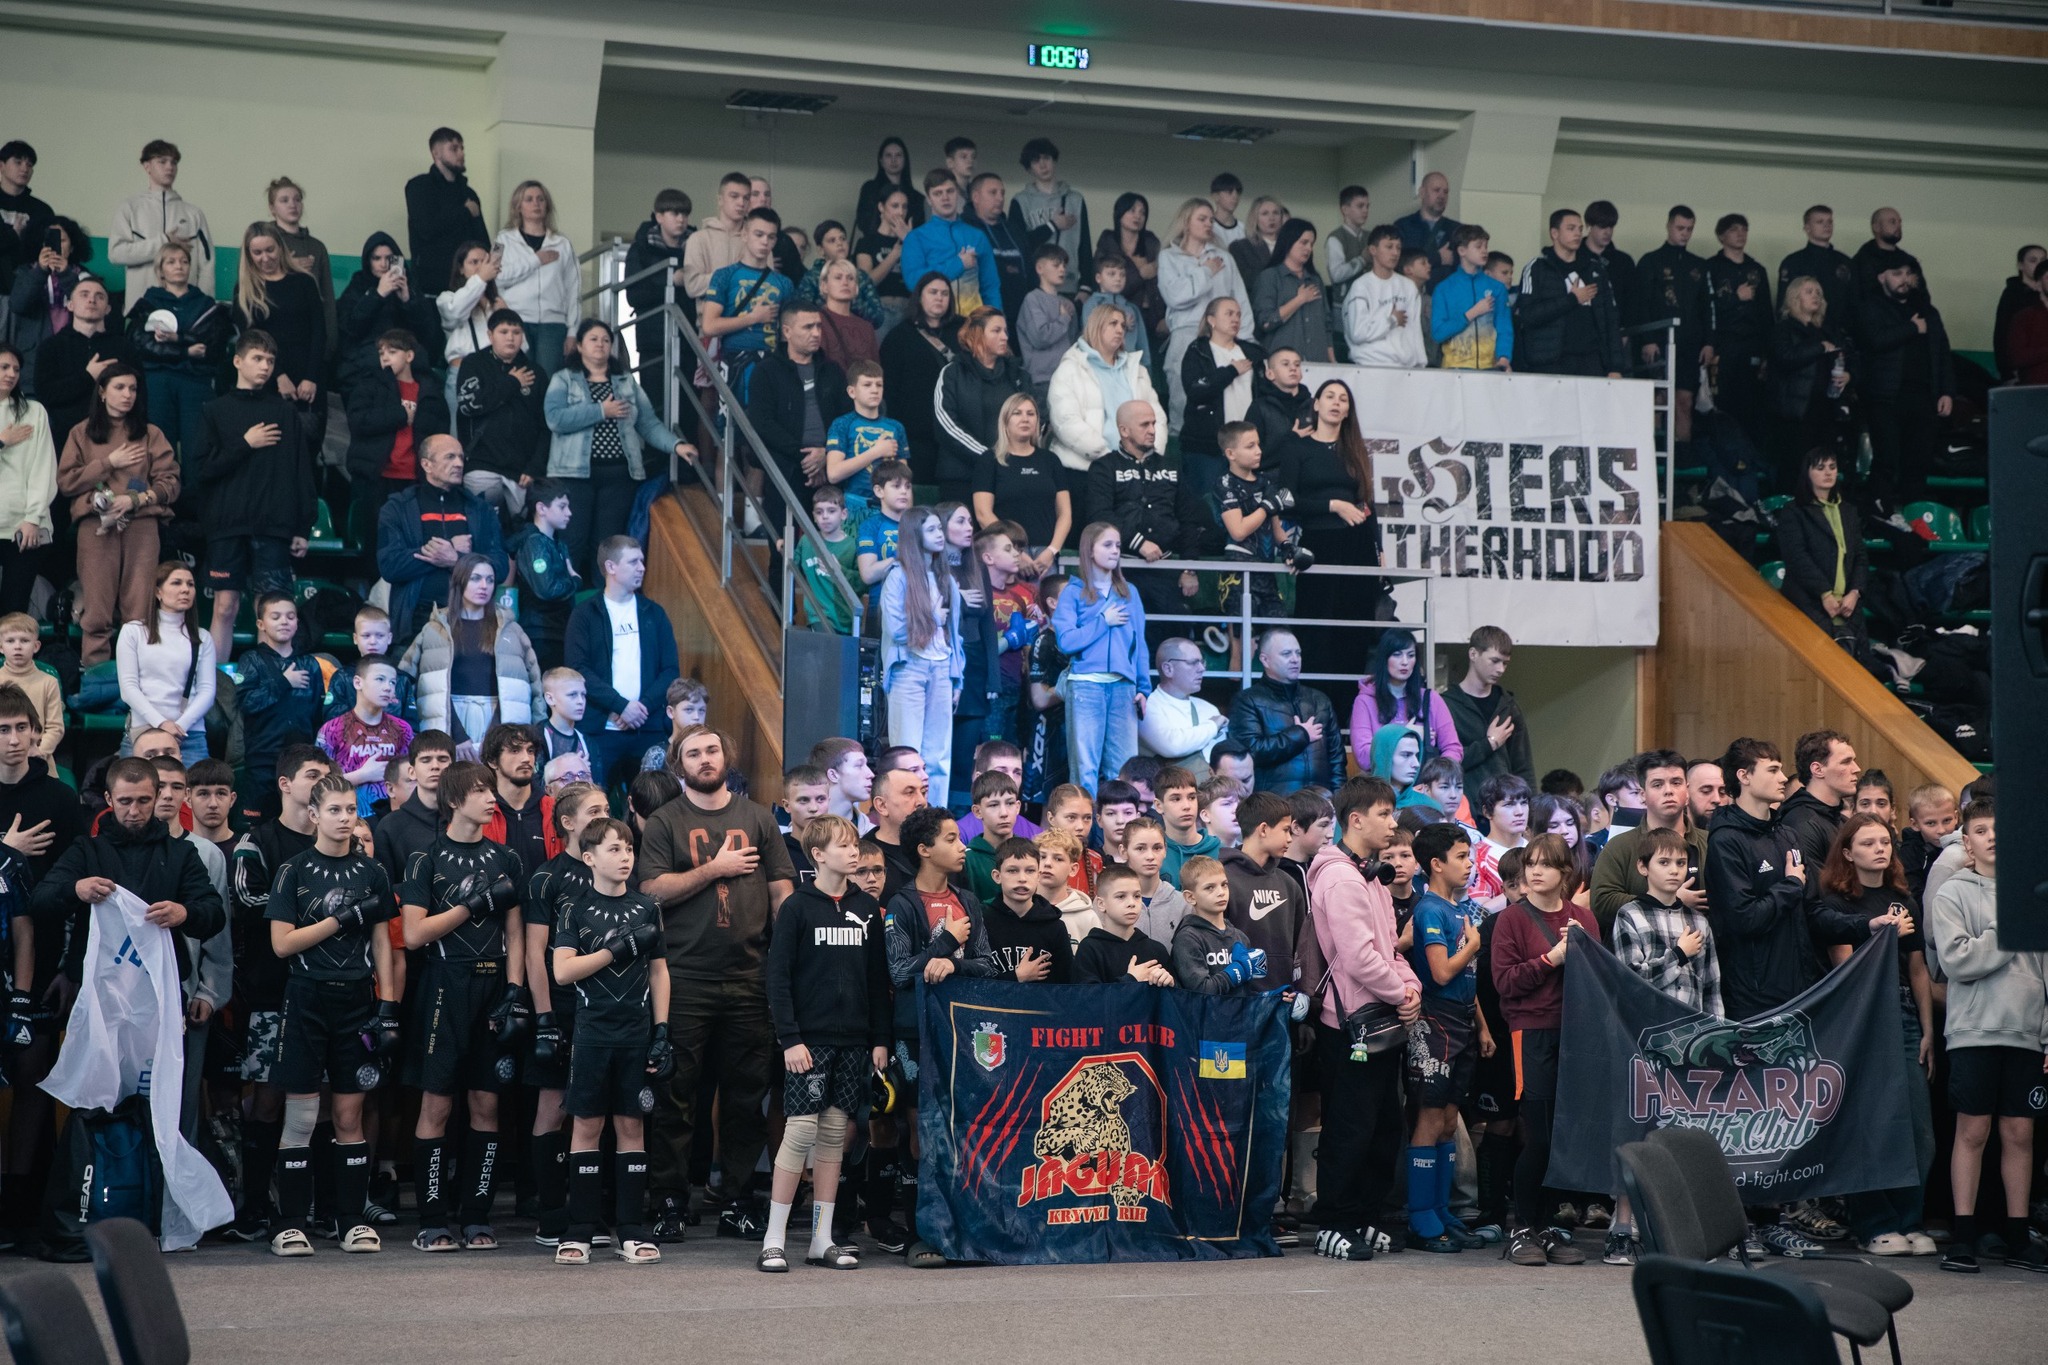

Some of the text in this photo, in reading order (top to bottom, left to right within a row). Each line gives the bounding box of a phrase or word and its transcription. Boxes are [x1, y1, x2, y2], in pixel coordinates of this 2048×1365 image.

[1376, 524, 1644, 582] THERHOOD
[350, 743, 396, 757] MANTO
[1032, 714, 1047, 775] RDX
[1253, 890, 1281, 904] NIKE
[814, 926, 862, 946] PUMA
[1206, 948, 1233, 966] adi
[1031, 1023, 1175, 1048] FIGHT CLUB
[1630, 1055, 1845, 1126] HAZARD
[1743, 1100, 1820, 1151] Club
[475, 1142, 498, 1197] BERSERK
[1017, 1149, 1173, 1208] JAGUAR
[1732, 1163, 1825, 1188] d-fight.com
[79, 1164, 94, 1223] HEAD
[1048, 1205, 1147, 1224] KRYVYI RIH
[284, 1229, 300, 1237] NIKE
[354, 1225, 370, 1233] NIKE
[1315, 1230, 1352, 1258] AIR
